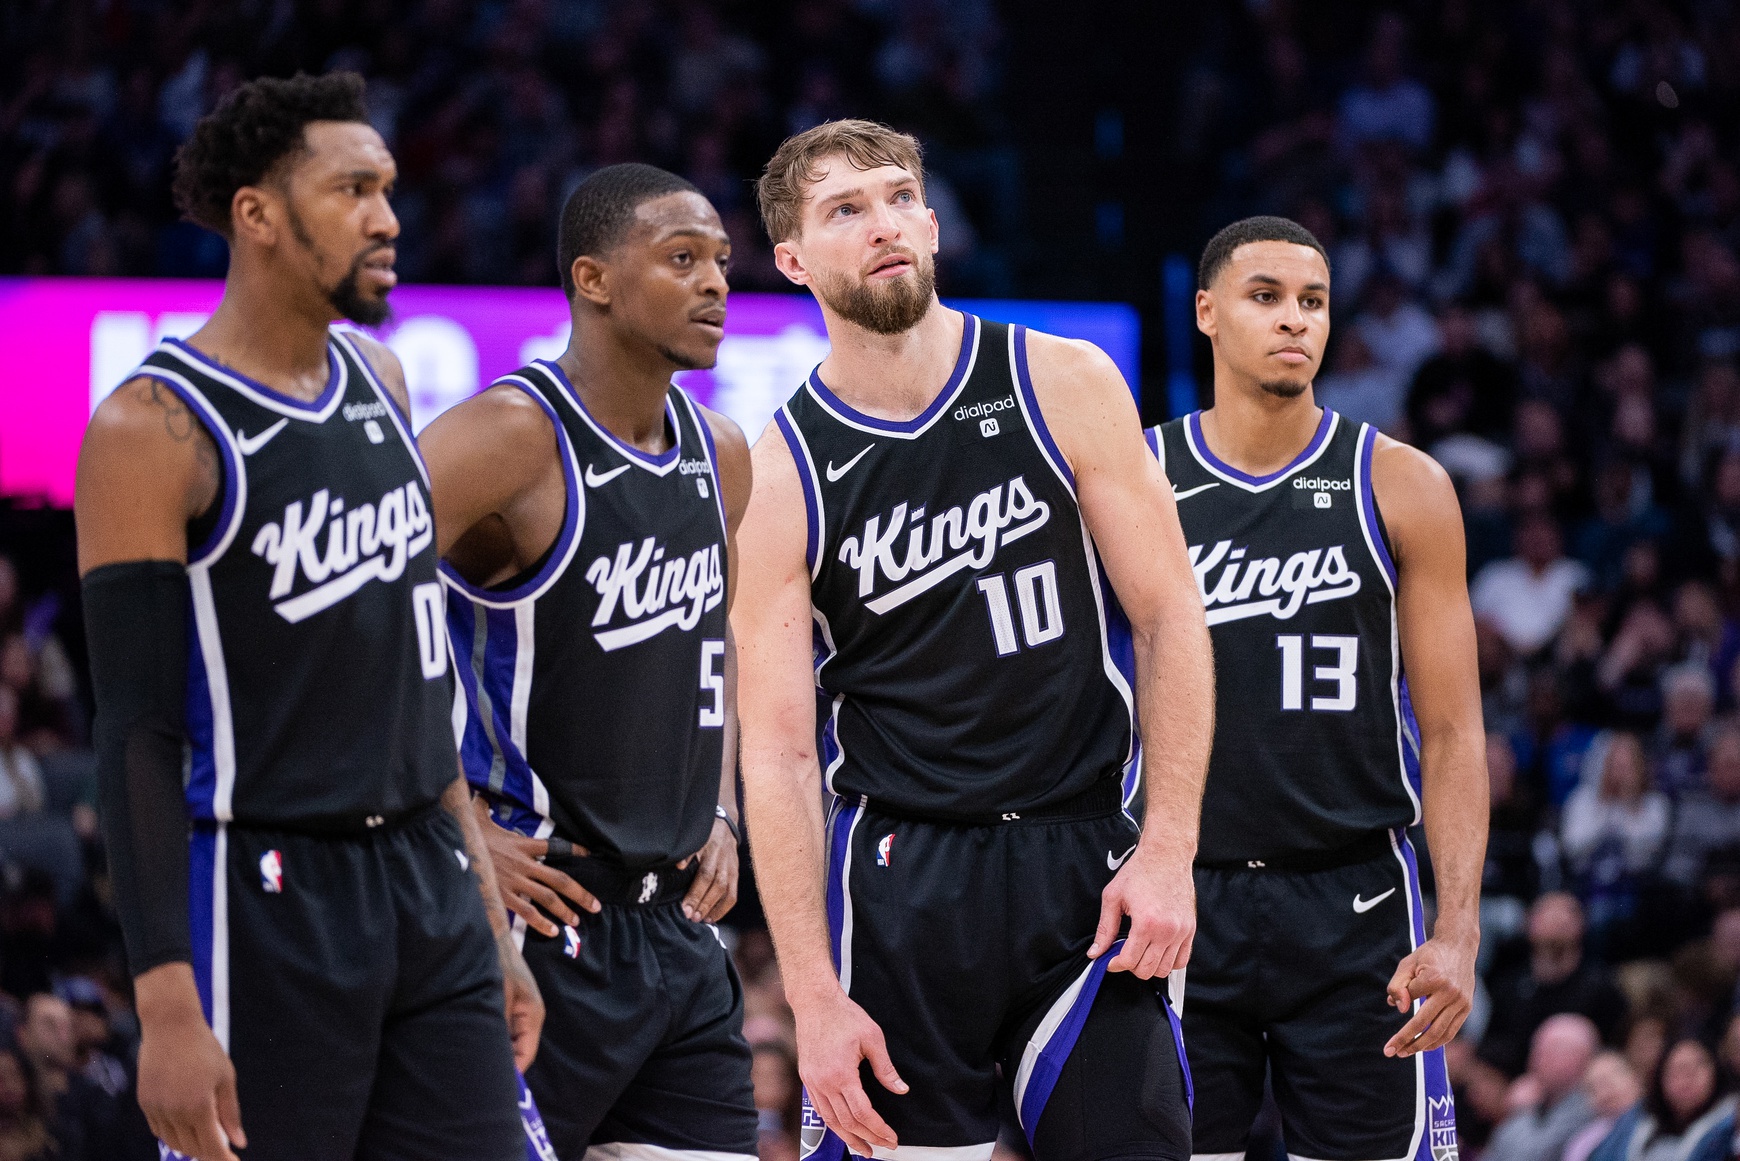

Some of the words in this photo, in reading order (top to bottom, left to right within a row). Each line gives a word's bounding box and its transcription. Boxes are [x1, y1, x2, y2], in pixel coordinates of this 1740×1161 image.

[954, 394, 1015, 421] dialpad
[1293, 476, 1351, 492] dialpad
[251, 480, 433, 624] Kings
[838, 475, 1050, 616] Kings
[1187, 539, 1361, 627] Kings
[412, 582, 448, 680] 0
[585, 536, 723, 652] Kings
[975, 558, 1065, 658] 10
[699, 640, 725, 727] 5
[1276, 633, 1359, 711] 13
